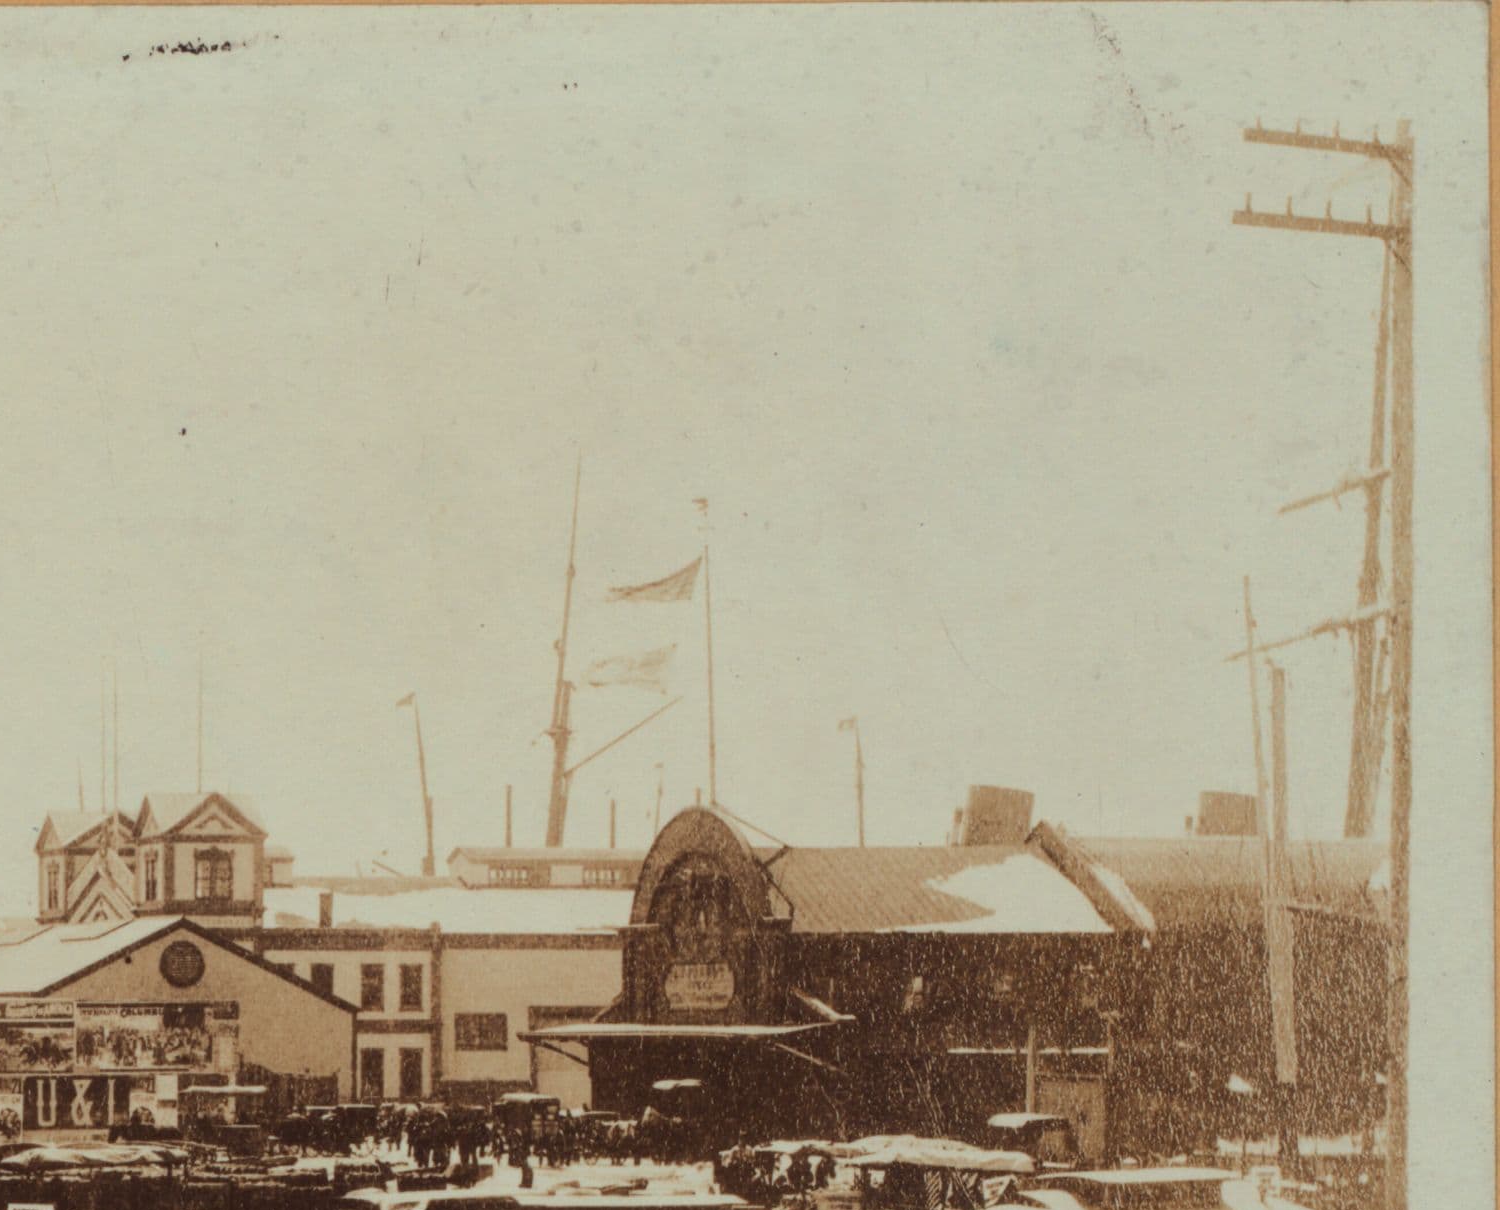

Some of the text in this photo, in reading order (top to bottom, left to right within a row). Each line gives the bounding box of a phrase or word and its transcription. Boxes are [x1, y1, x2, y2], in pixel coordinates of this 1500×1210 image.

[37, 1079, 57, 1126] U
[71, 1079, 93, 1126] &
[107, 1079, 116, 1126] I
